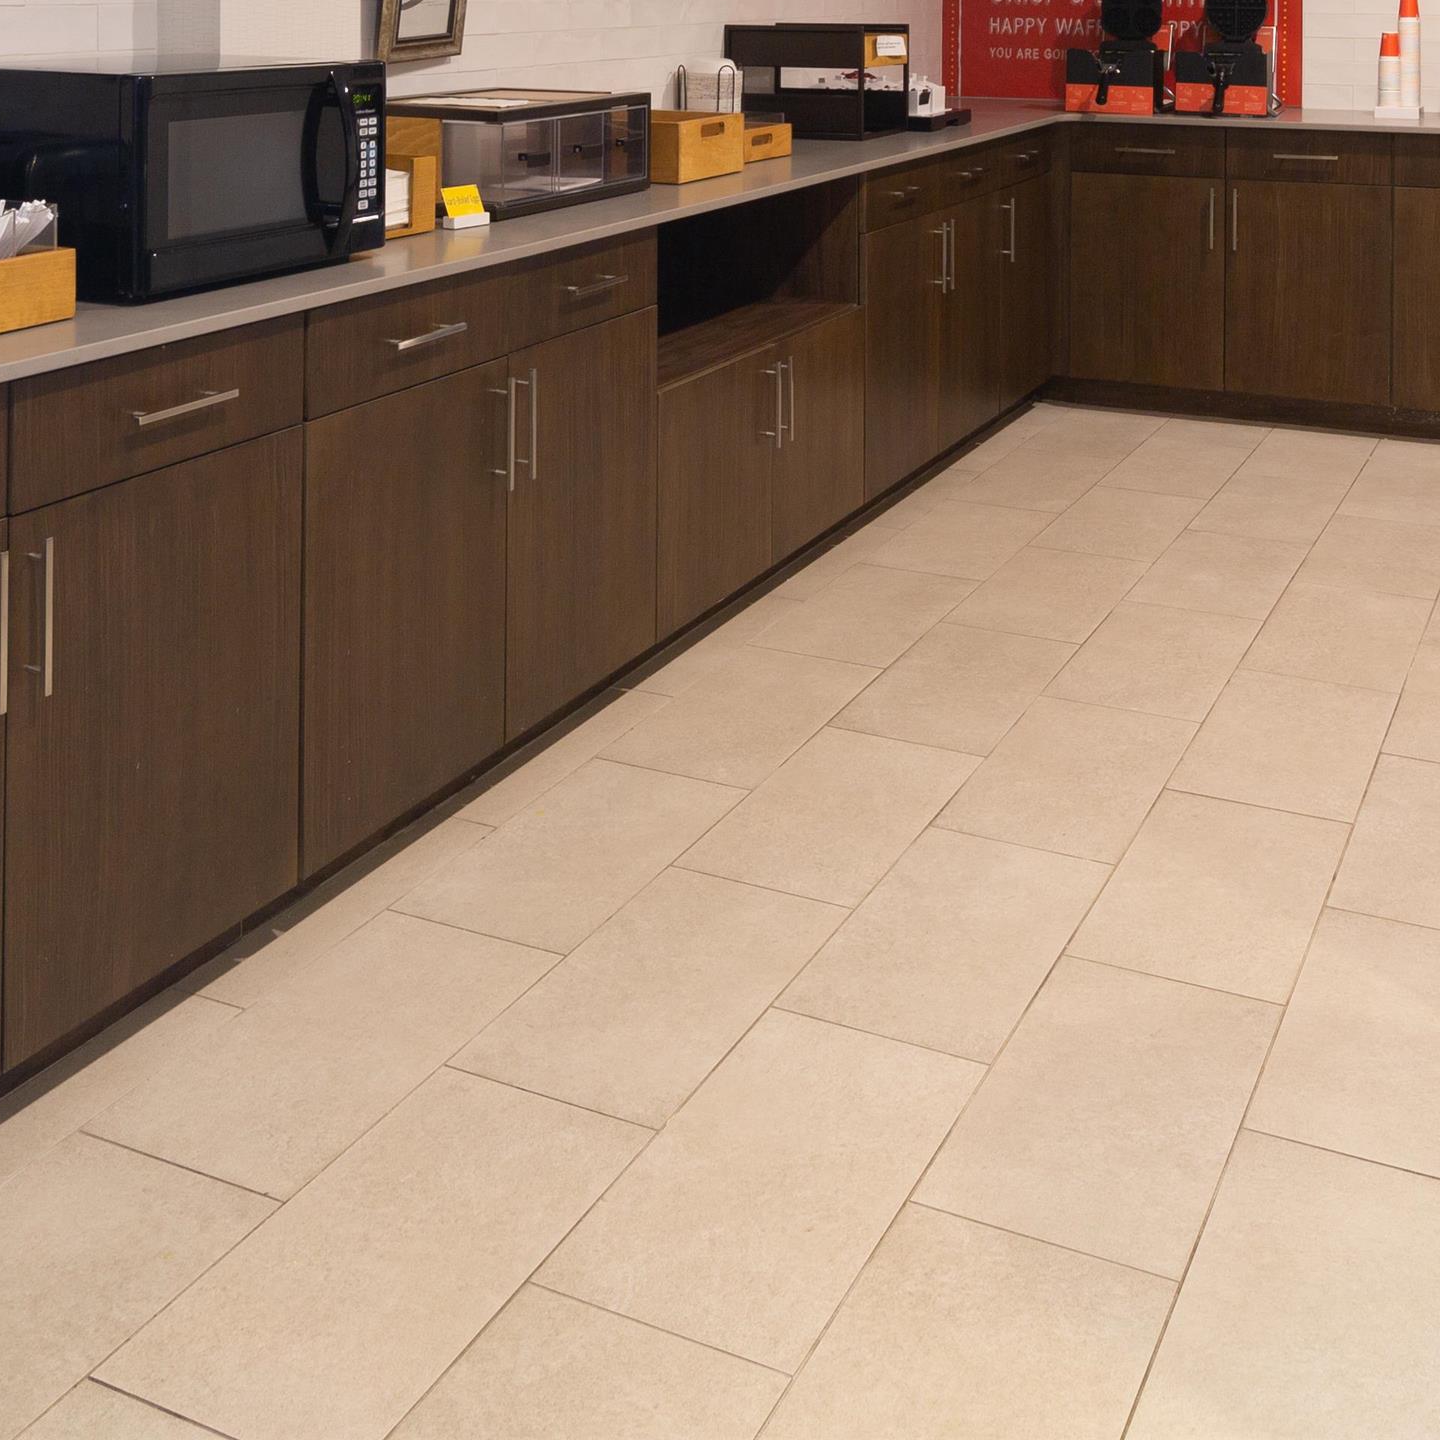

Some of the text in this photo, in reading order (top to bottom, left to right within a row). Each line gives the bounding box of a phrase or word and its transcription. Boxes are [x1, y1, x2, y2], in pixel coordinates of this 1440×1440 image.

[989, 17, 1048, 35] HAPPY
[989, 47, 1013, 59] YOU
[1016, 48, 1040, 60] ARE
